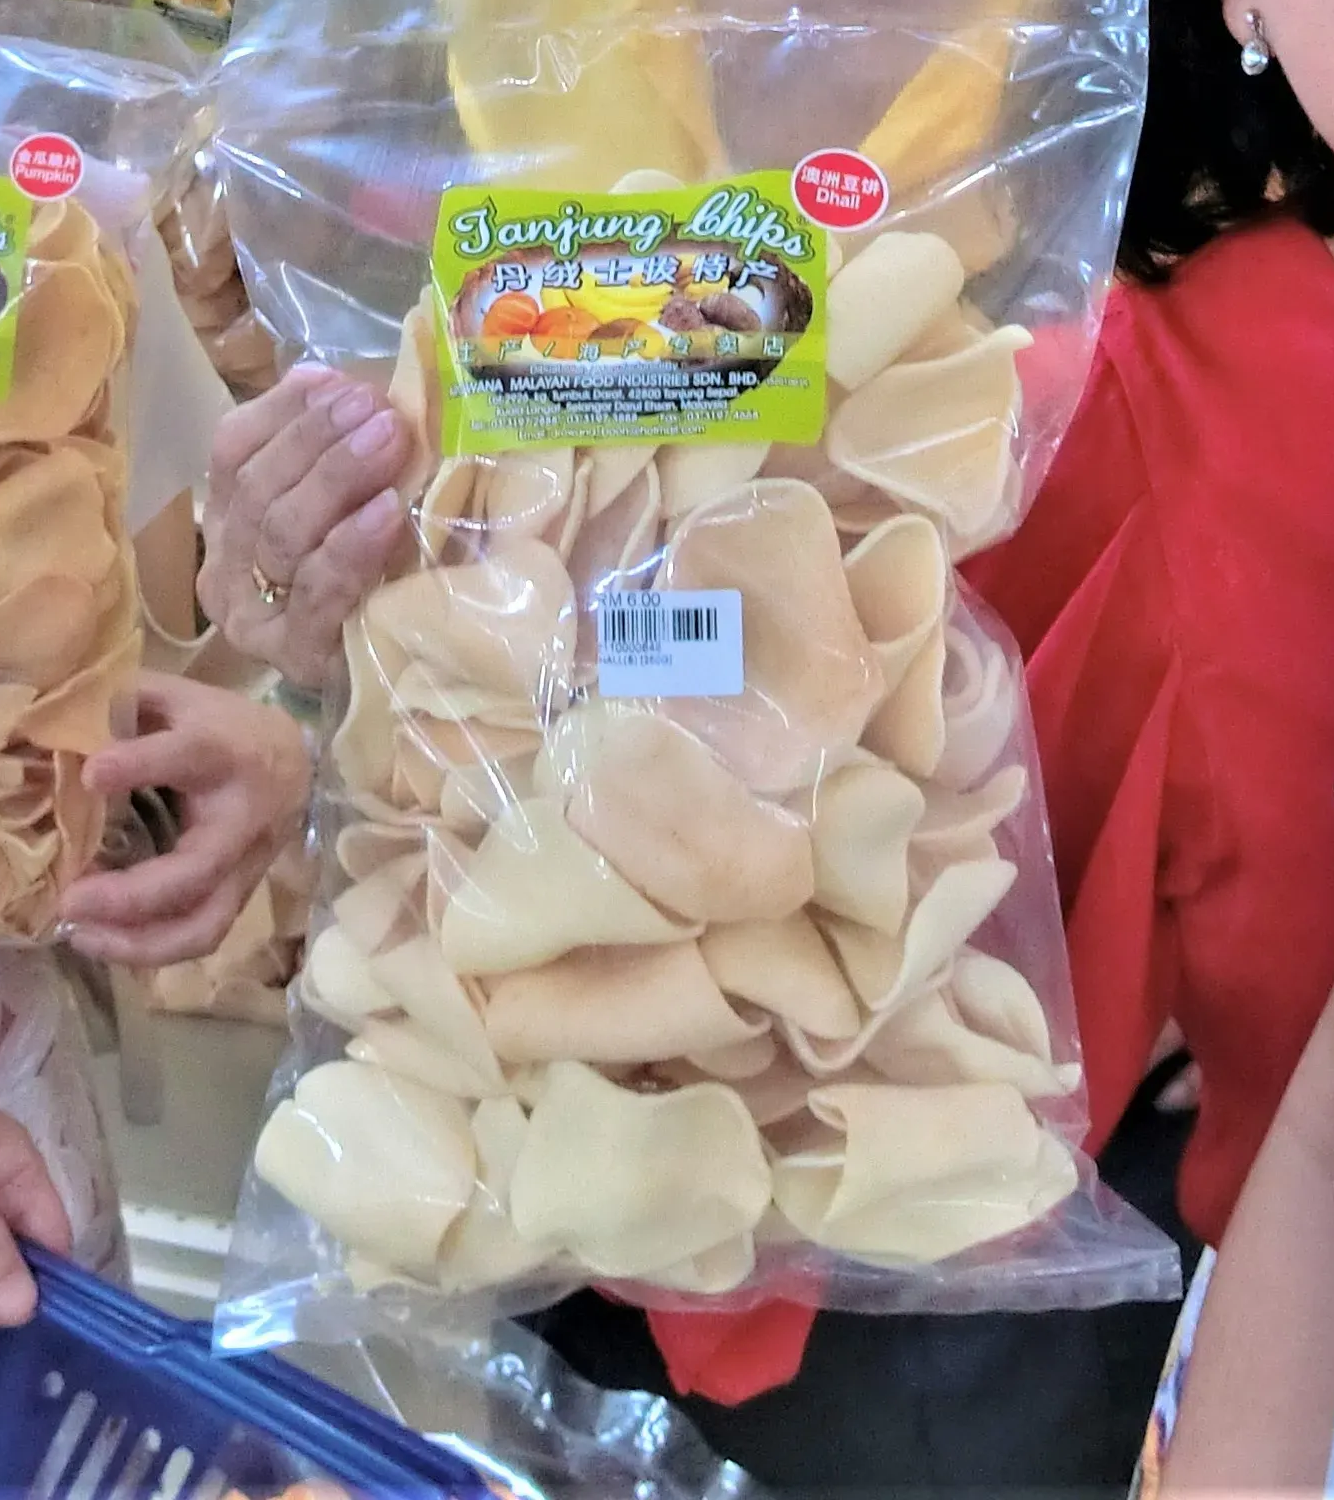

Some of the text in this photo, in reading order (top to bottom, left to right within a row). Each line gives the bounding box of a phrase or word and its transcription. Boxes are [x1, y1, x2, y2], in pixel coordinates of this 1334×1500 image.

[15, 164, 75, 184] Pumpkin
[815, 186, 861, 210] Dhall
[452, 190, 807, 257] Tanjung Chips
[510, 376, 571, 392] MALAYAN
[573, 375, 615, 389] FOOD
[618, 372, 690, 387] INDUSTRIES
